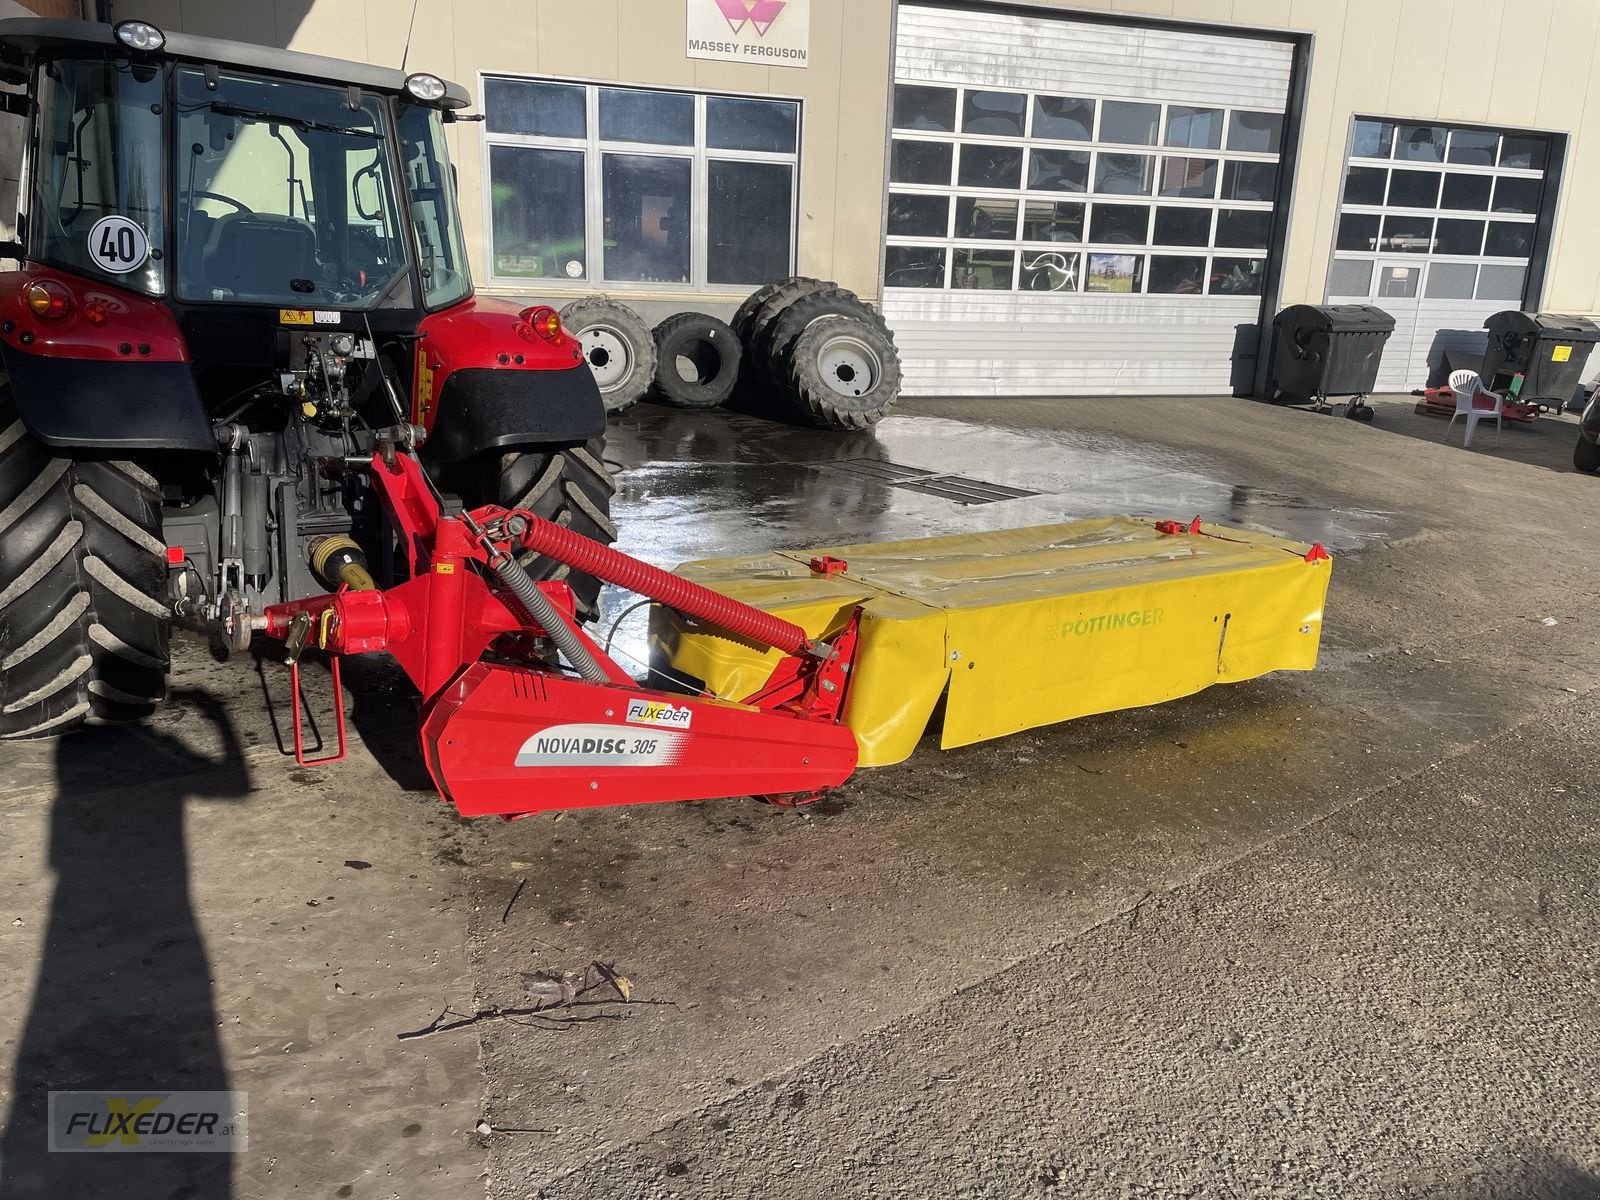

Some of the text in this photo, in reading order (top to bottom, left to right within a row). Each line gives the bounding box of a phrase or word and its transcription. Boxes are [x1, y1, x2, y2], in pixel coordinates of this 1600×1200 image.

[688, 39, 807, 60] MASSEY FERGUSON
[99, 226, 135, 263] 40
[628, 705, 690, 722] FLIXEDER
[536, 738, 658, 754] NOVADISC 305
